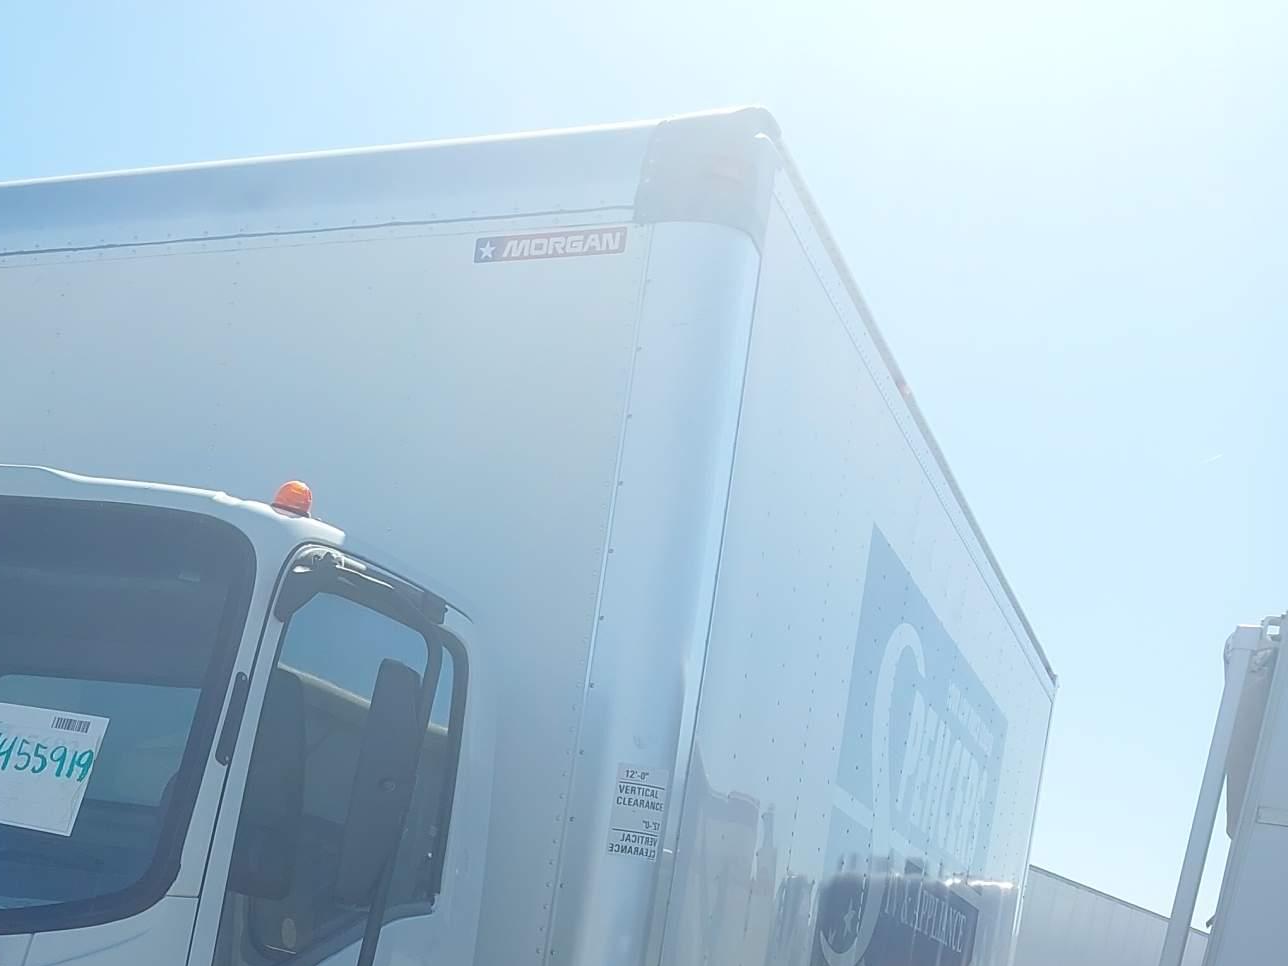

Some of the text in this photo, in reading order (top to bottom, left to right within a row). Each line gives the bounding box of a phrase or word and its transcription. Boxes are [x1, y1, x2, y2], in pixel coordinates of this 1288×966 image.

[503, 232, 622, 257] MORGAN
[619, 784, 659, 799] VERTICAL
[616, 796, 664, 811] CLEARANCE
[910, 874, 967, 954] APPLIANCE
